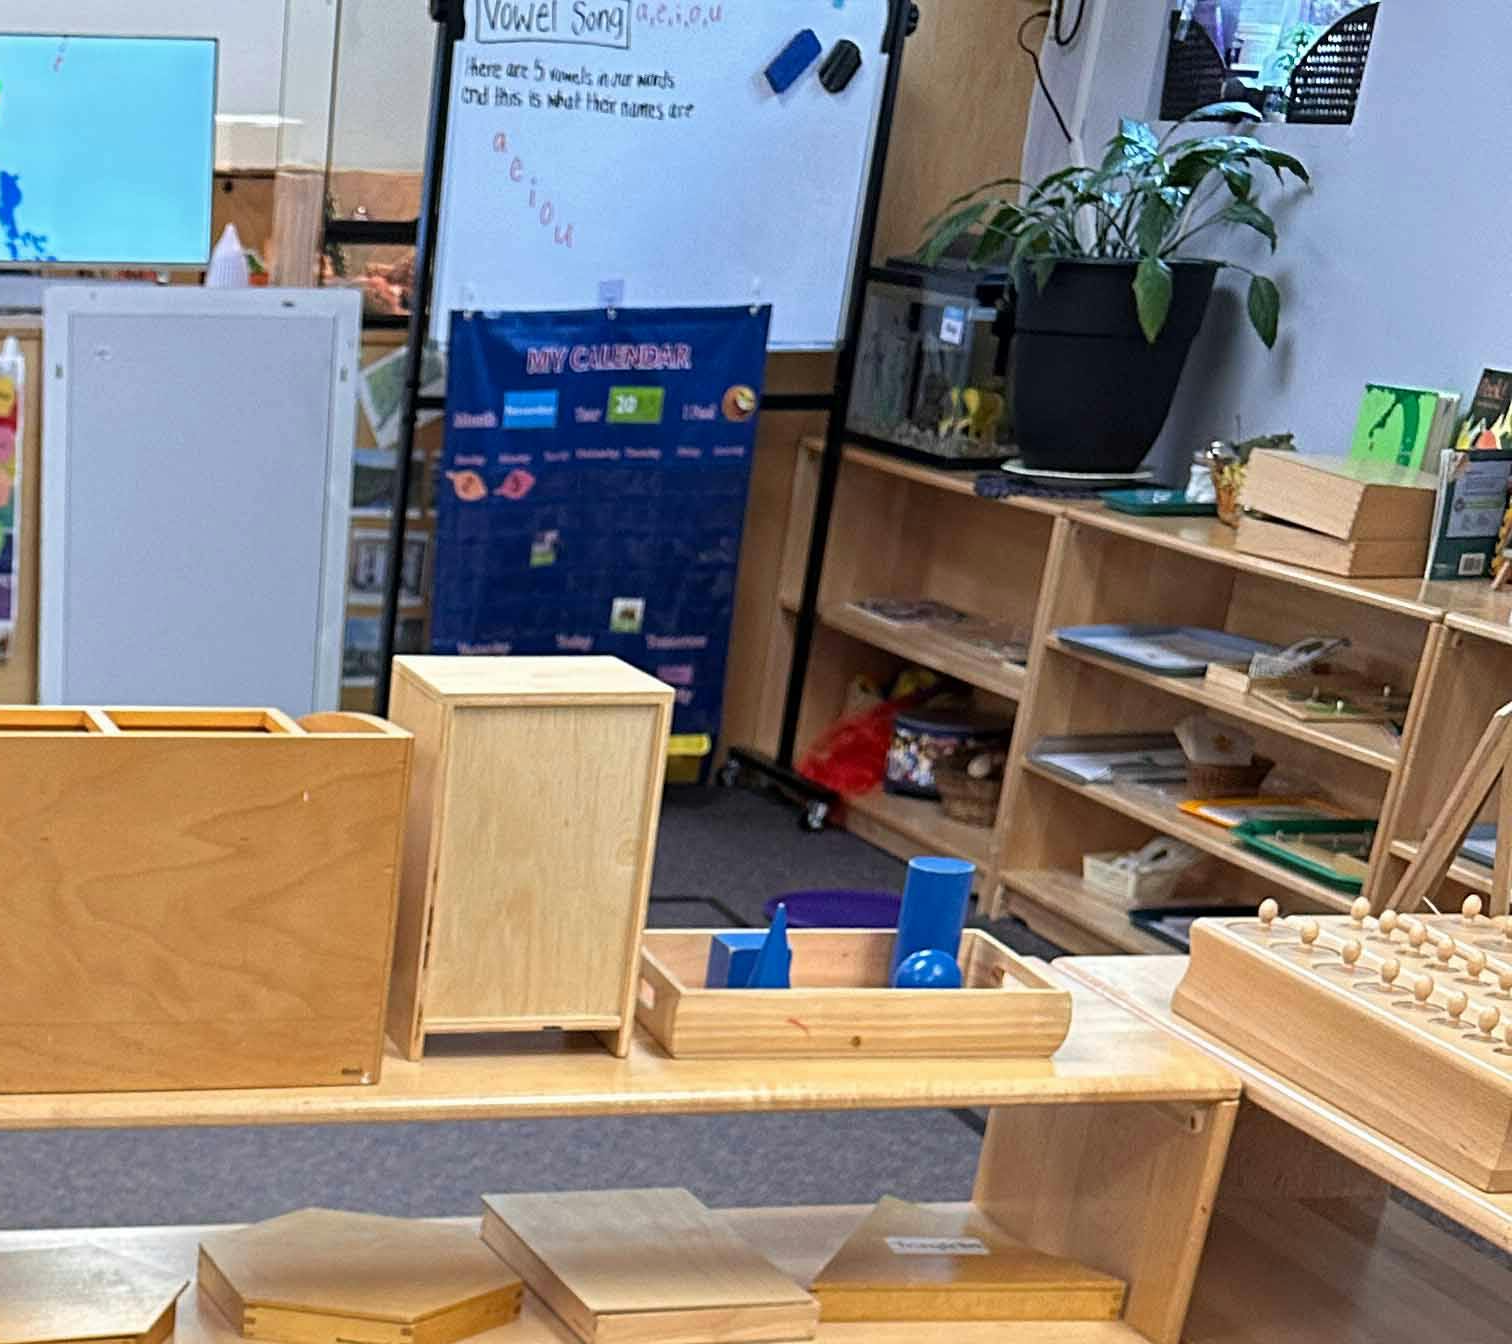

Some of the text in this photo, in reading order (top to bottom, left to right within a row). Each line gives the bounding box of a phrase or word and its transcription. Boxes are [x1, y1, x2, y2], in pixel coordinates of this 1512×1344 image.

[486, 0, 624, 39] Vowel Song
[549, 65, 592, 87] vowels
[638, 70, 675, 89] words
[621, 99, 664, 121] names
[668, 102, 694, 118] are
[526, 342, 692, 374] MY CALENDAR
